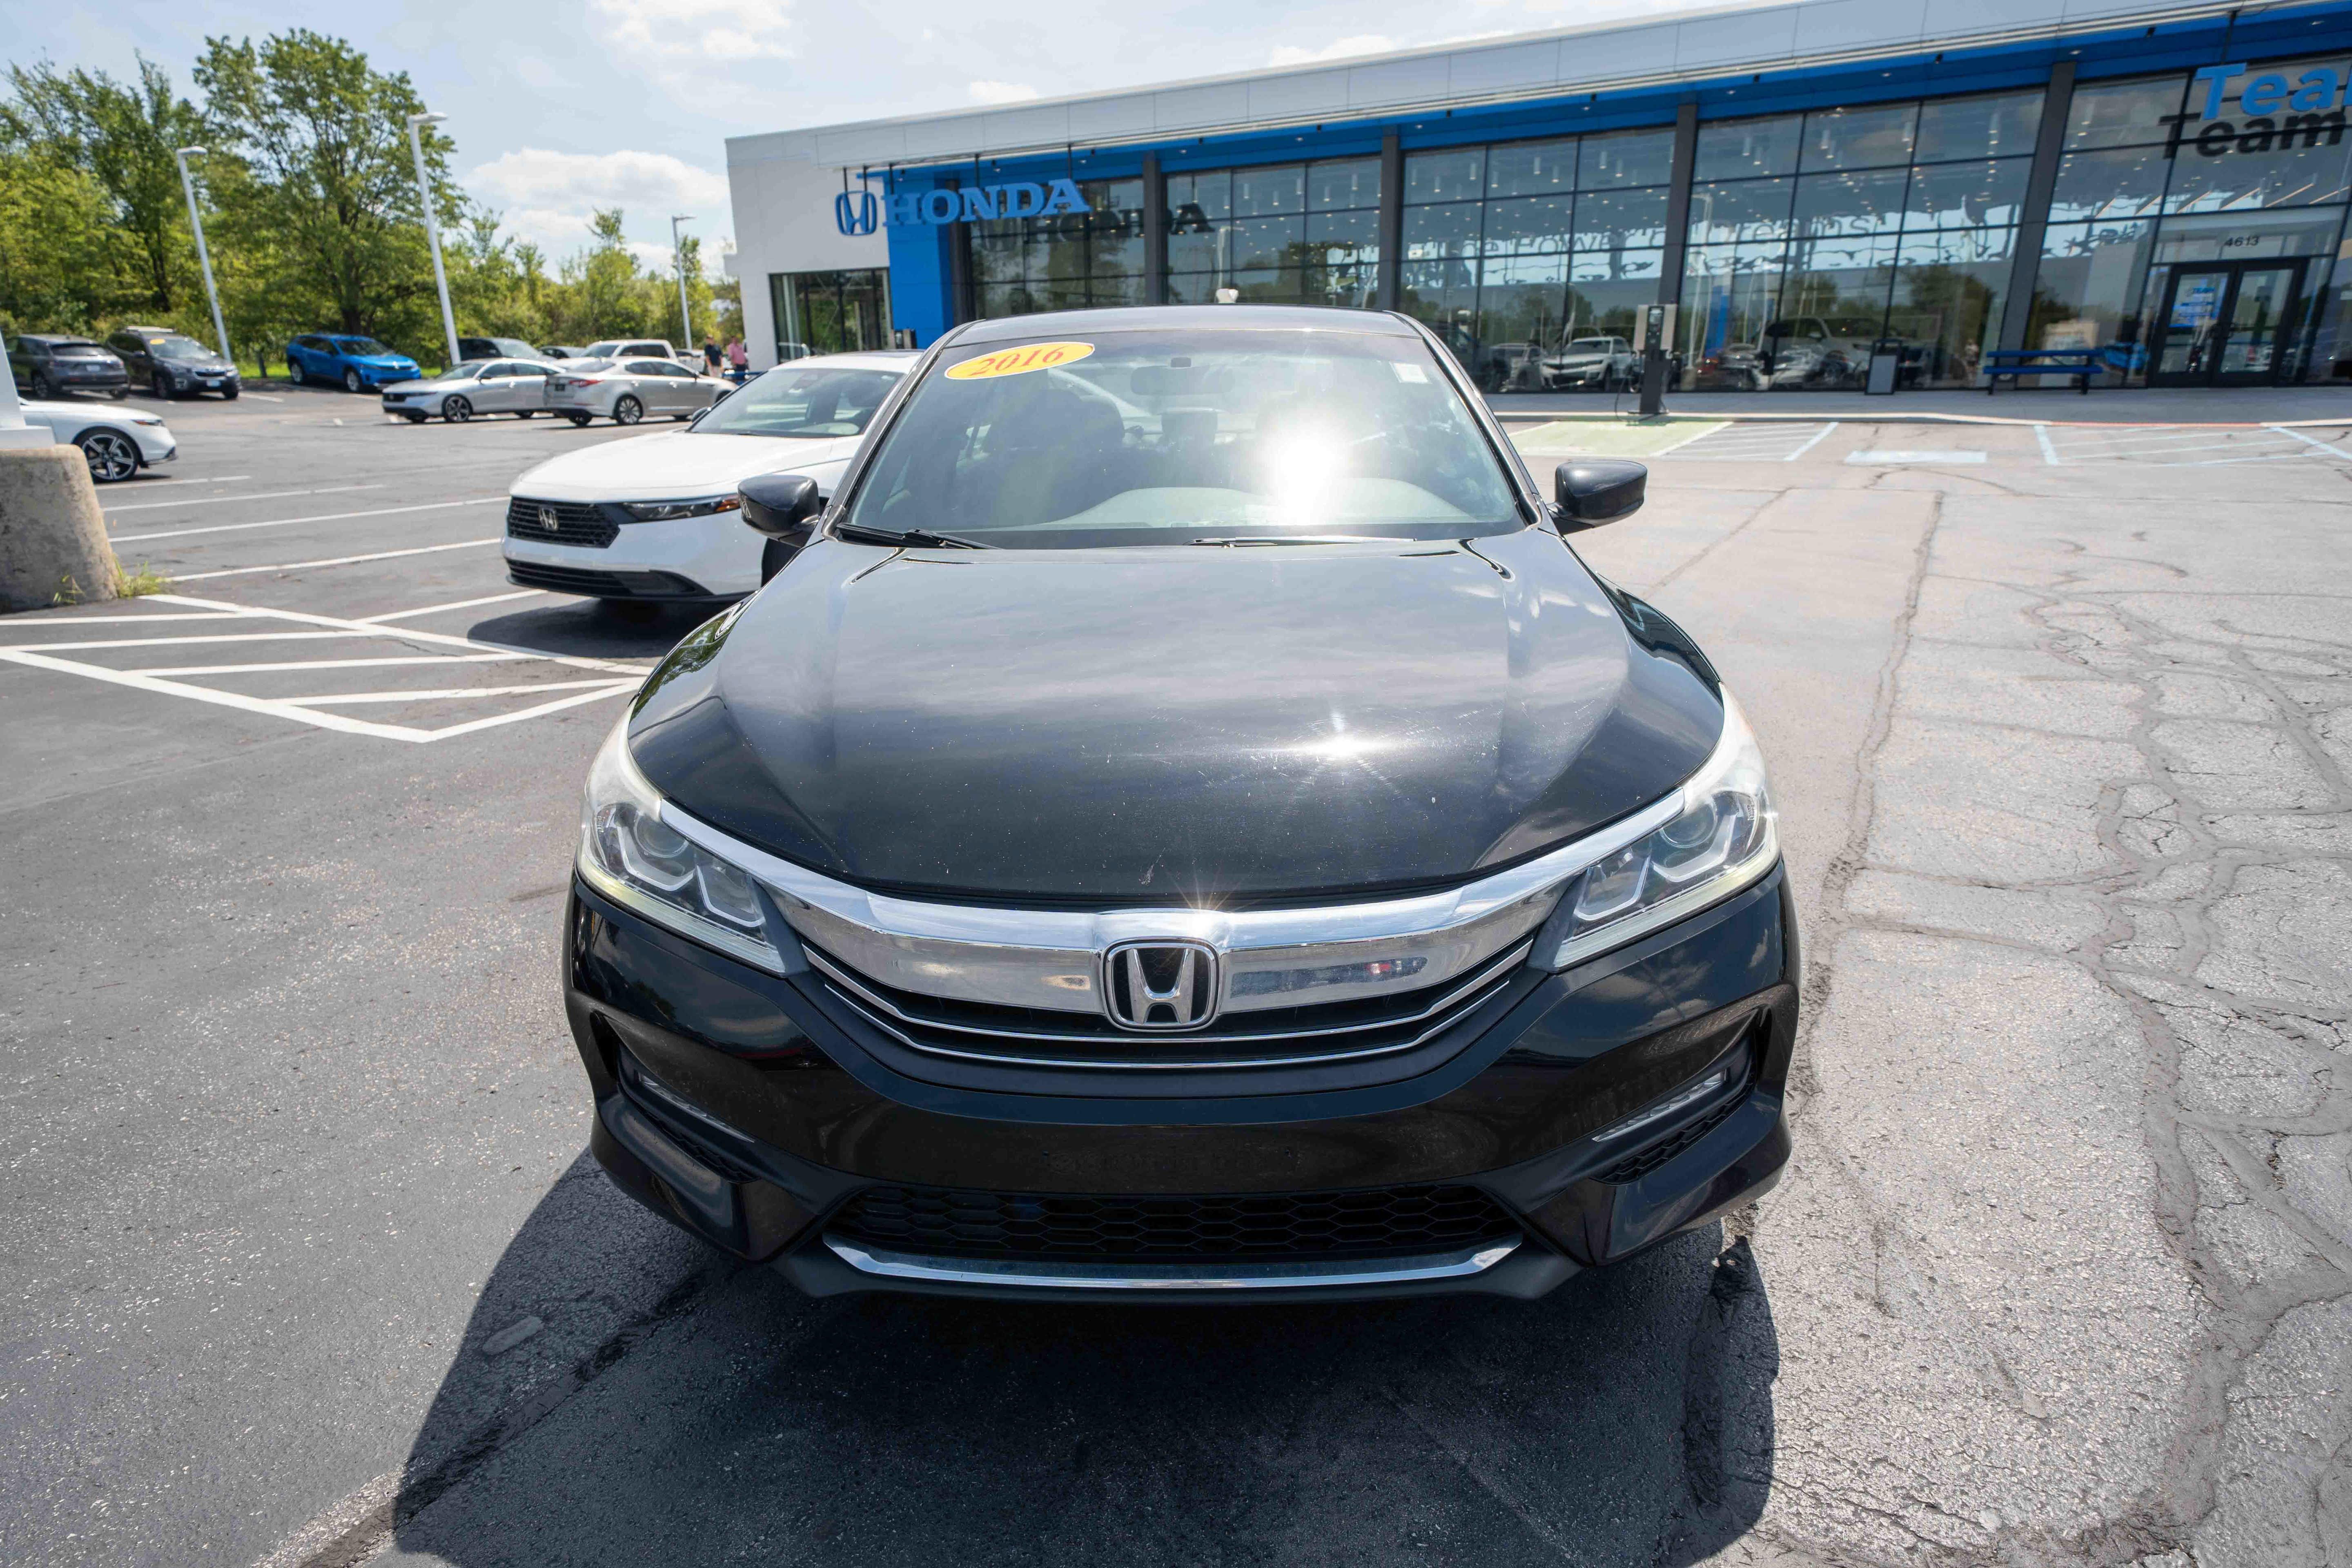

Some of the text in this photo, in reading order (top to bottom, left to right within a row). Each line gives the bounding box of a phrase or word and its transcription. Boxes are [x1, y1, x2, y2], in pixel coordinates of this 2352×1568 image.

[2195, 63, 2352, 119] Tea
[882, 178, 1091, 226] HONDA
[2224, 235, 2260, 247] 4613
[969, 345, 1069, 376] 2016
